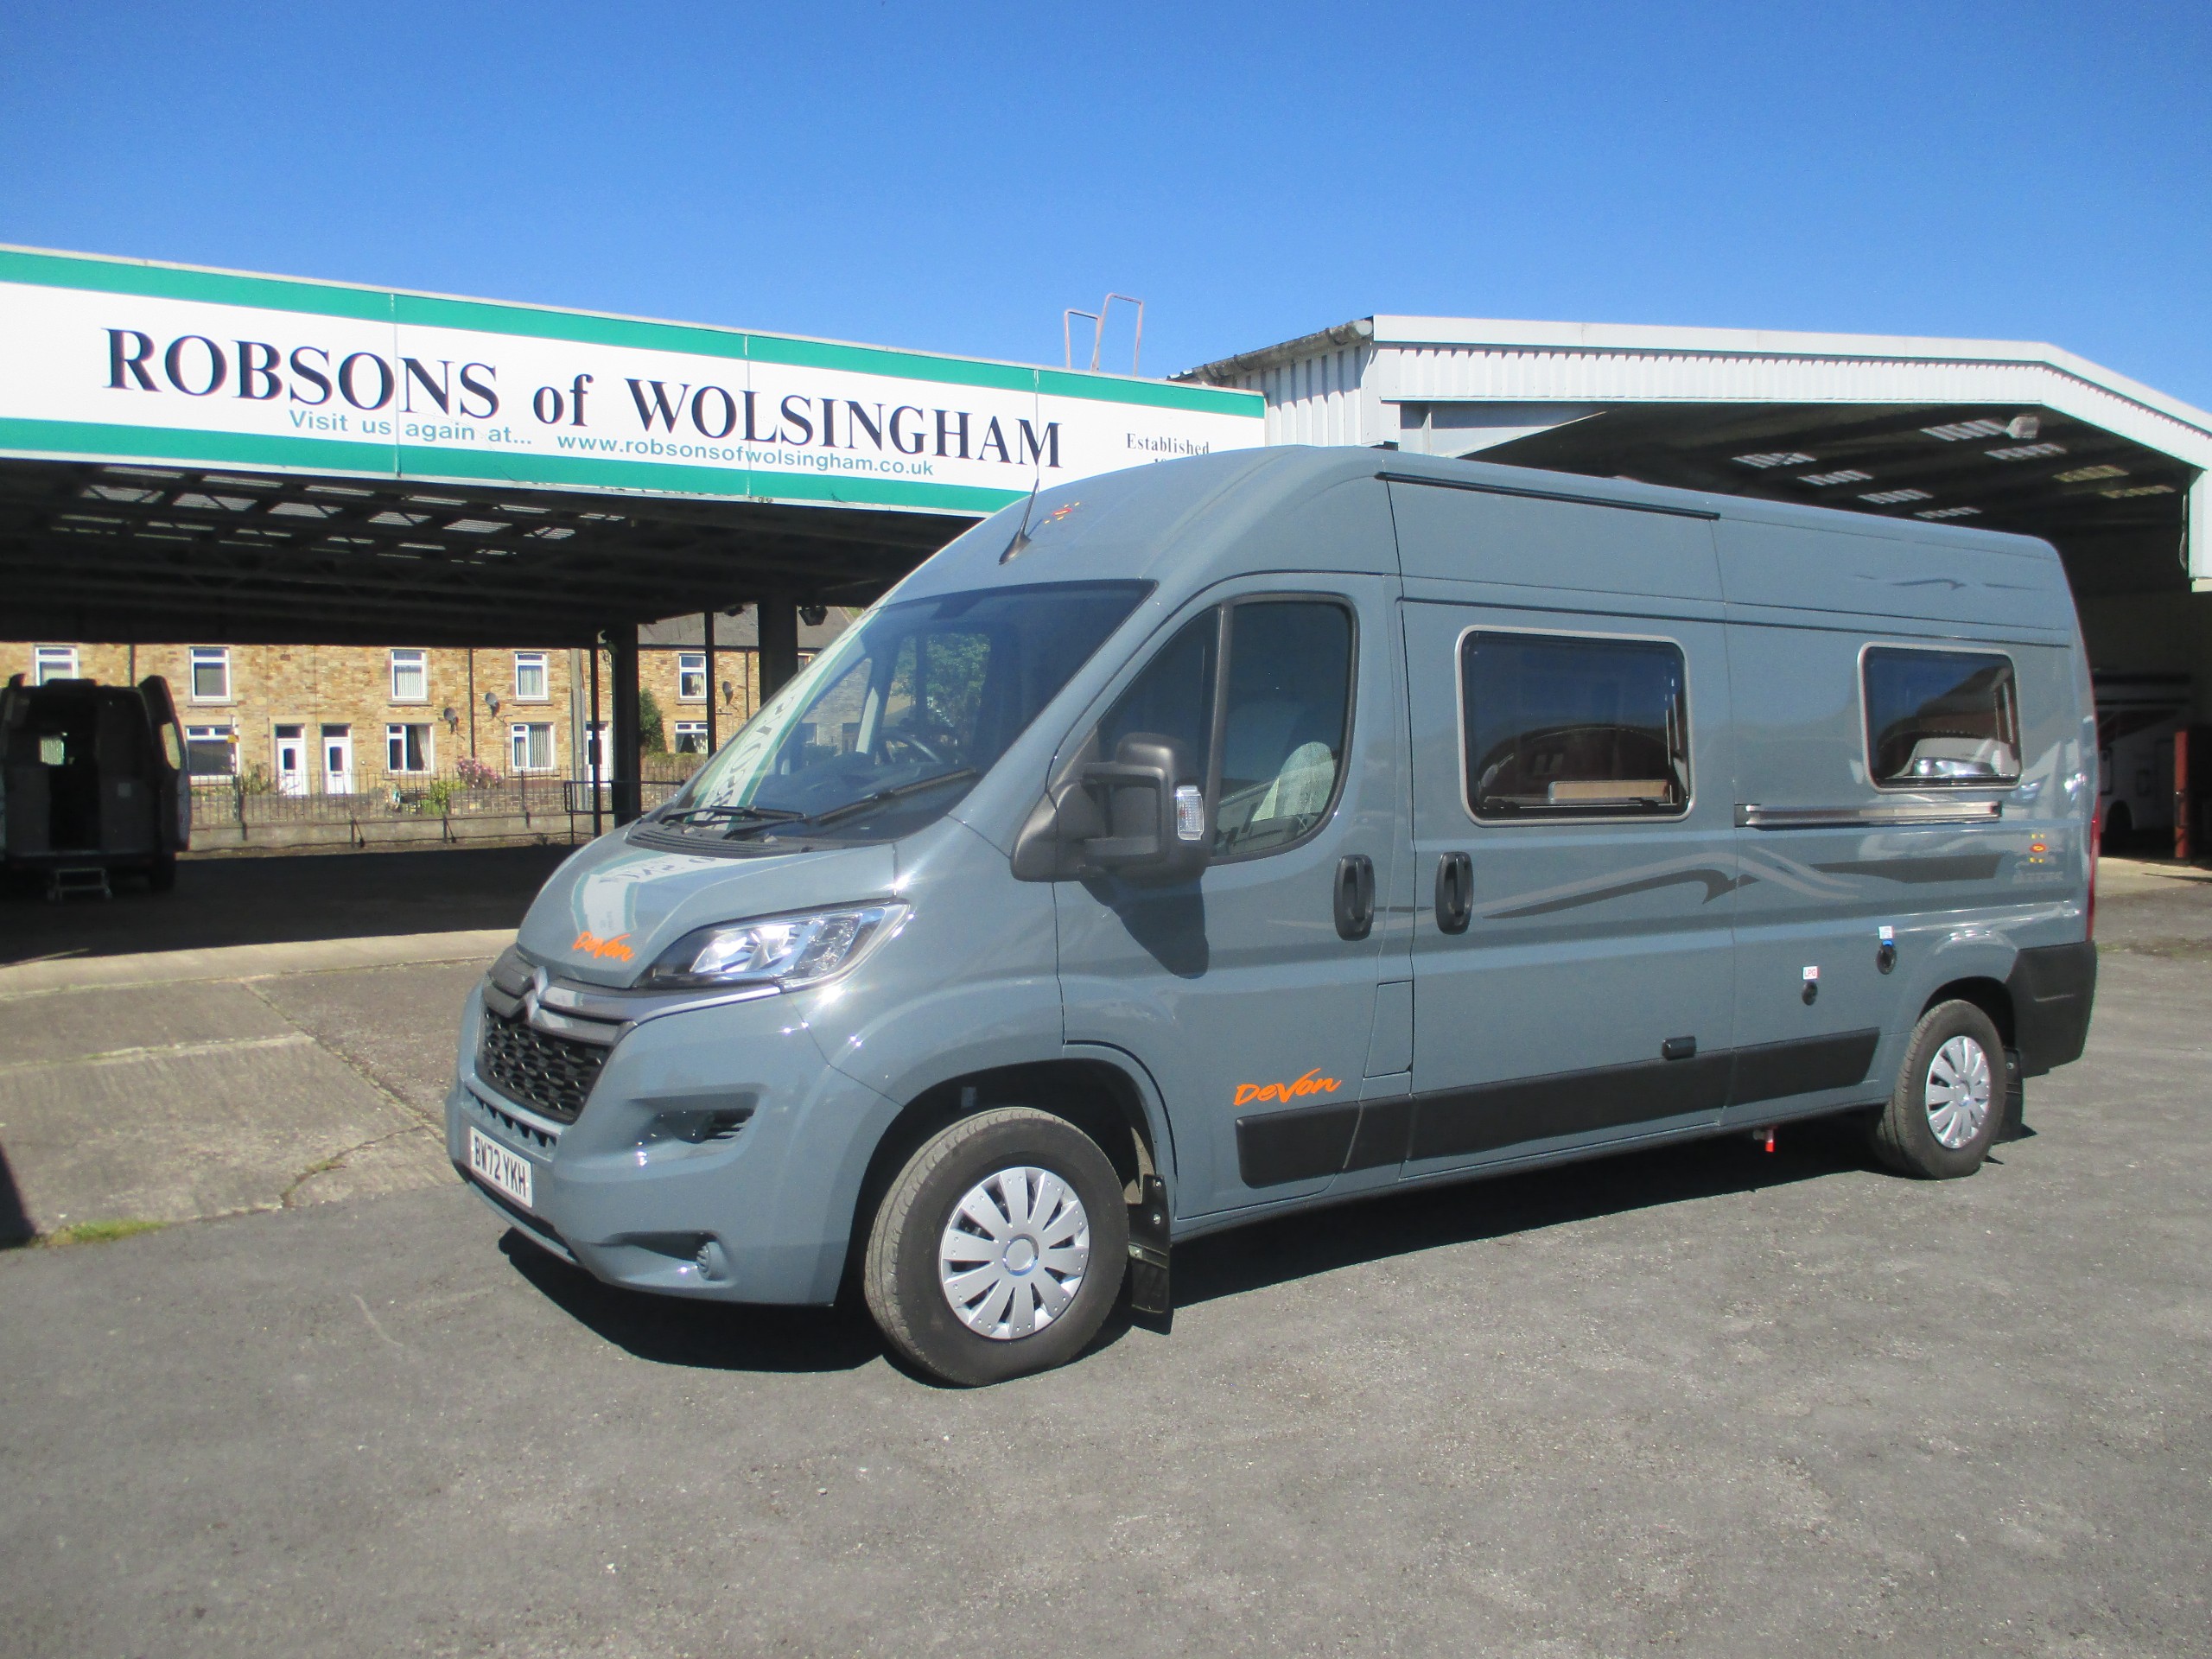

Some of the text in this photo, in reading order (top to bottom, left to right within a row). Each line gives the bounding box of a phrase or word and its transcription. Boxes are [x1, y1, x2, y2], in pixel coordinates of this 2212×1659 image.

[101, 327, 1064, 470] ROBSONS of WOLSINGHAM
[289, 410, 934, 476] Visit us again at... www.robsonsofwolsingham.co.uk
[1127, 433, 1209, 456] Established
[503, 1153, 526, 1198] YKH
